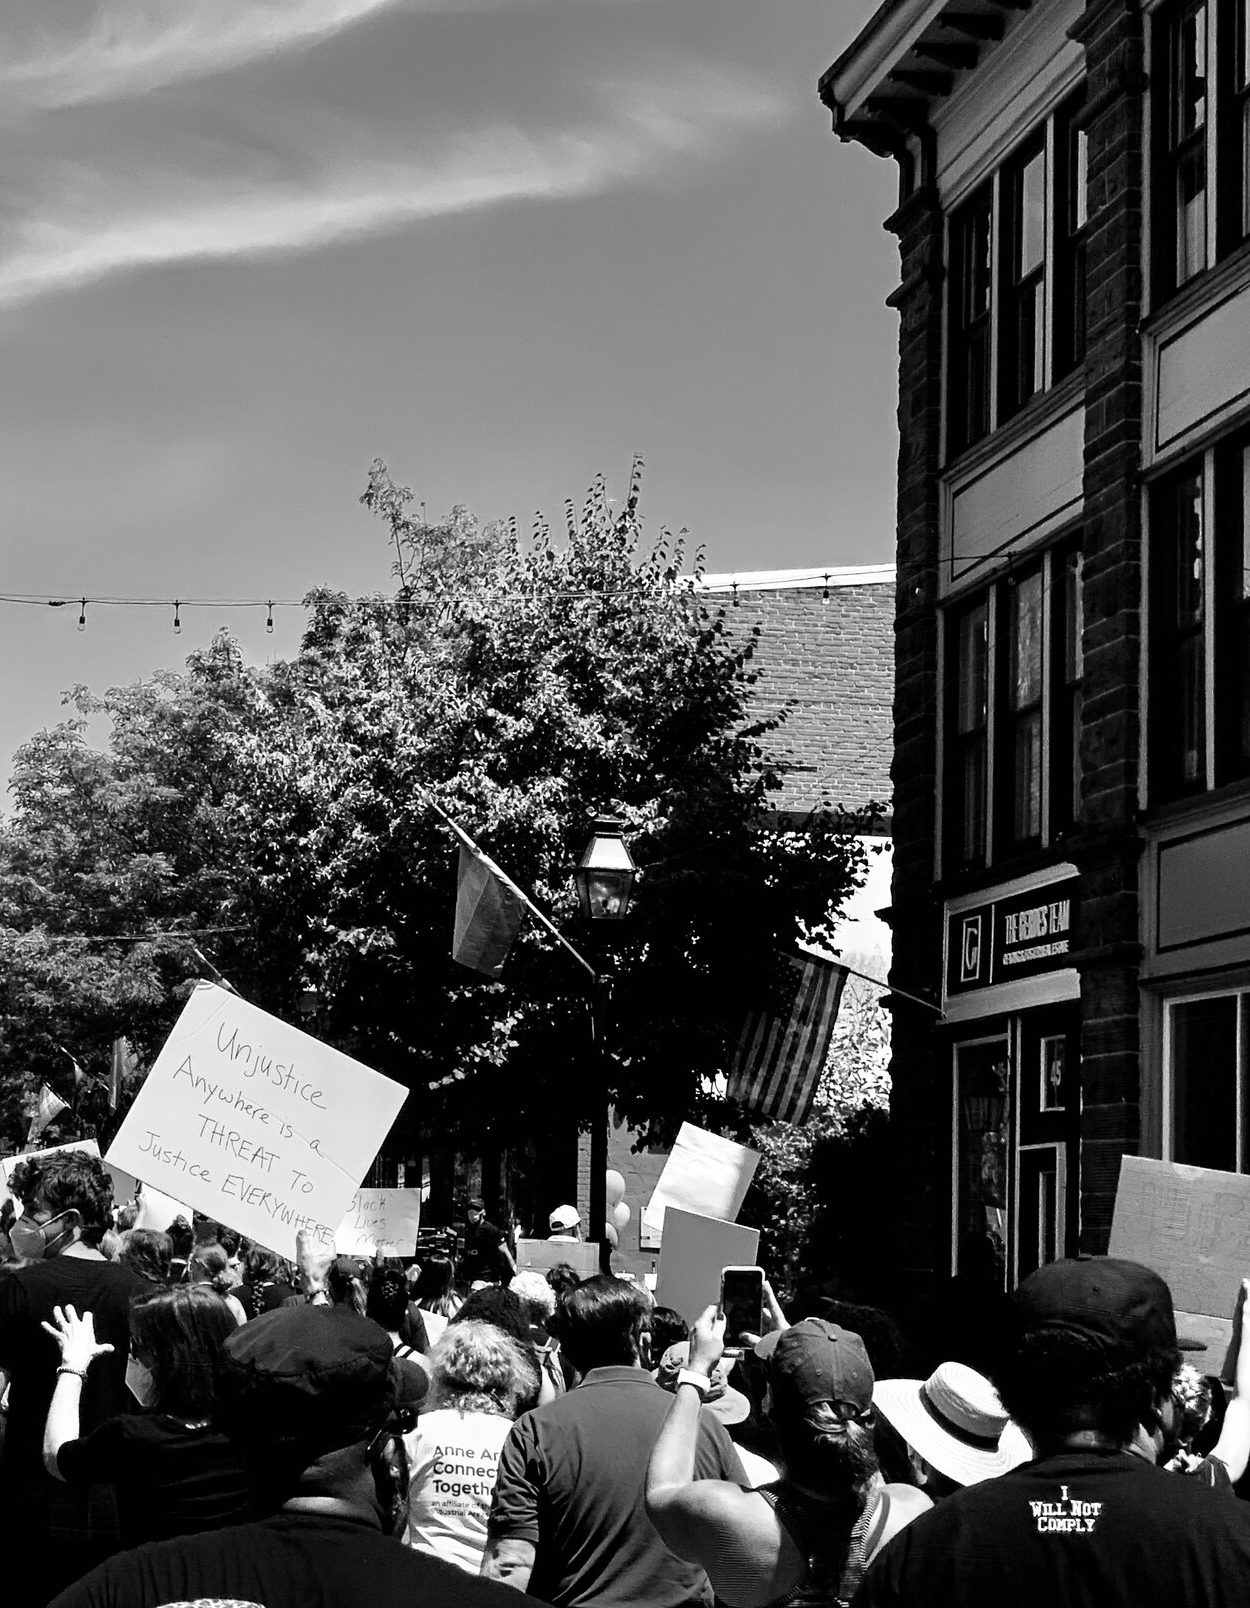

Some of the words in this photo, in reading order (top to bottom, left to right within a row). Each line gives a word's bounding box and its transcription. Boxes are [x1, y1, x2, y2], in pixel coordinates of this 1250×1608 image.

[217, 1022, 327, 1110] Unjustice
[172, 1055, 269, 1125] Anywhere
[279, 1116, 293, 1139] is
[309, 1139, 325, 1159] a
[138, 1130, 212, 1183] Justice
[198, 1113, 281, 1173] THREAT
[433, 1446, 475, 1459] Anne
[433, 1461, 499, 1479] Connec
[1060, 1485, 1069, 1501] I
